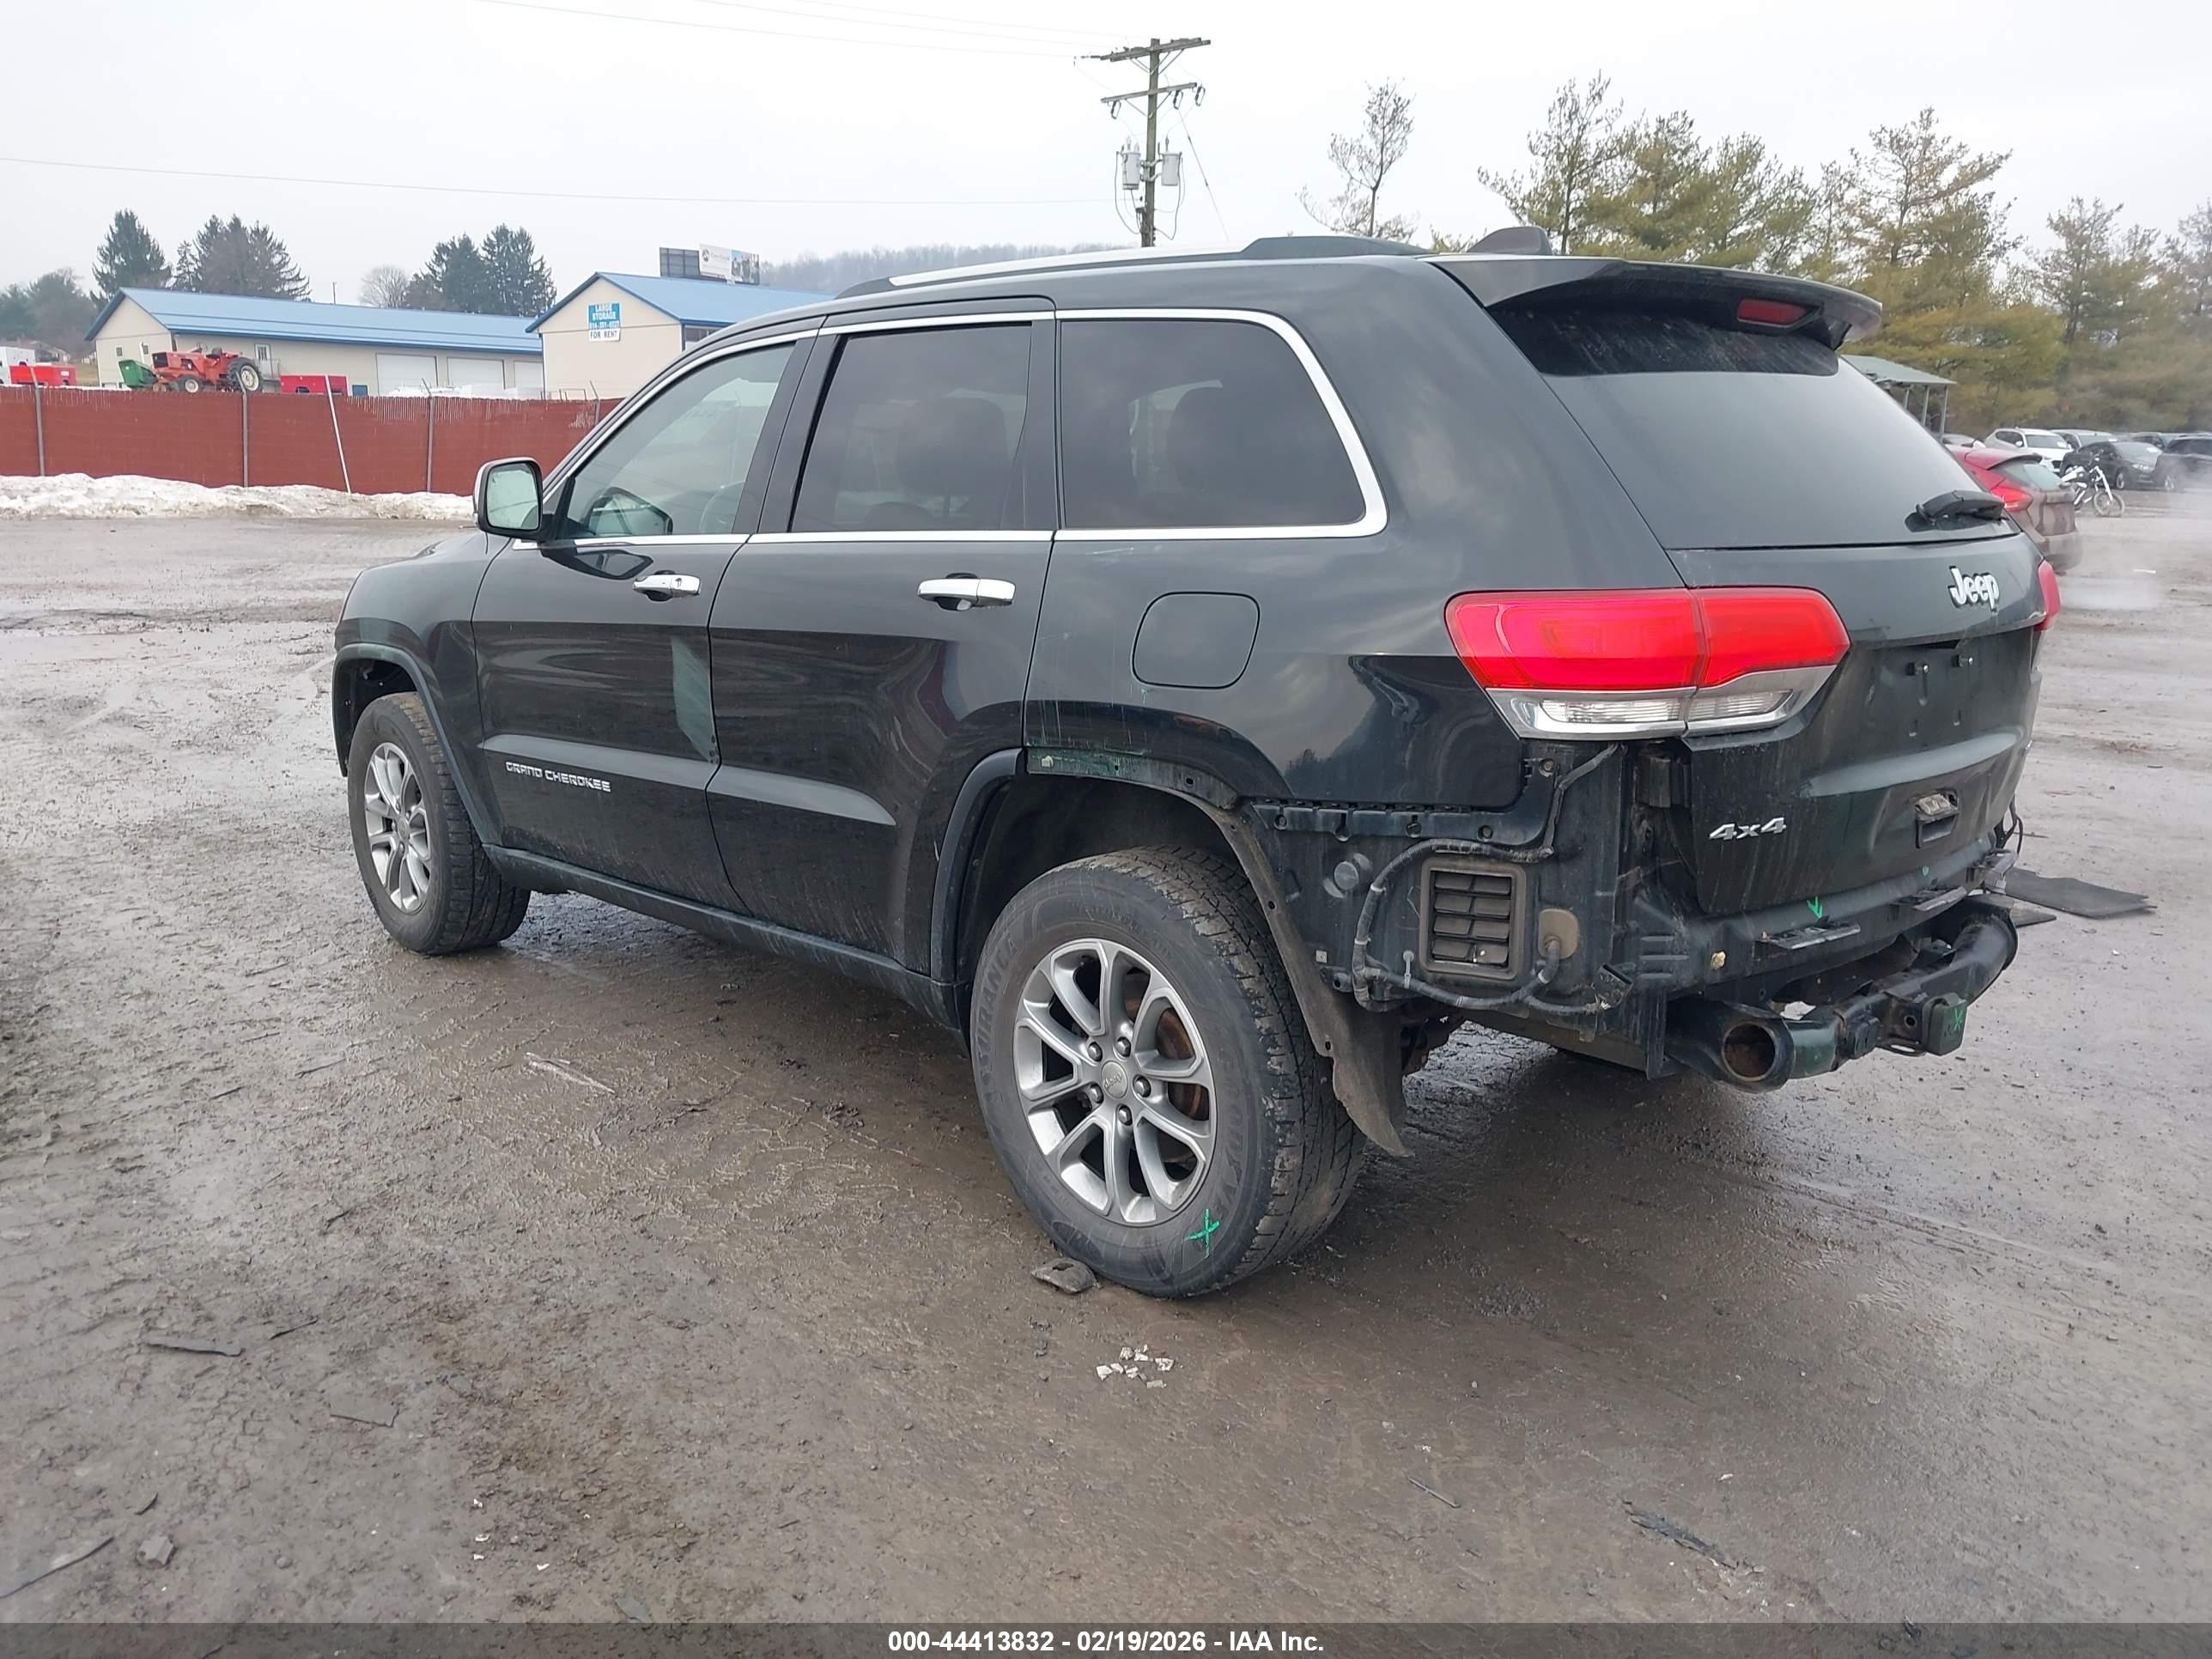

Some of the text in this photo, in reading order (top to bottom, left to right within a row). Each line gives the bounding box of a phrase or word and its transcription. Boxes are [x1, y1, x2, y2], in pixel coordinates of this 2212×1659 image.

[592, 311, 616, 321] STORAGE
[590, 330, 617, 339] FOR RENT
[1948, 566, 2000, 611] Jeep
[505, 761, 611, 793] GRAND CHEROKEE
[1708, 817, 1787, 841] 4x4
